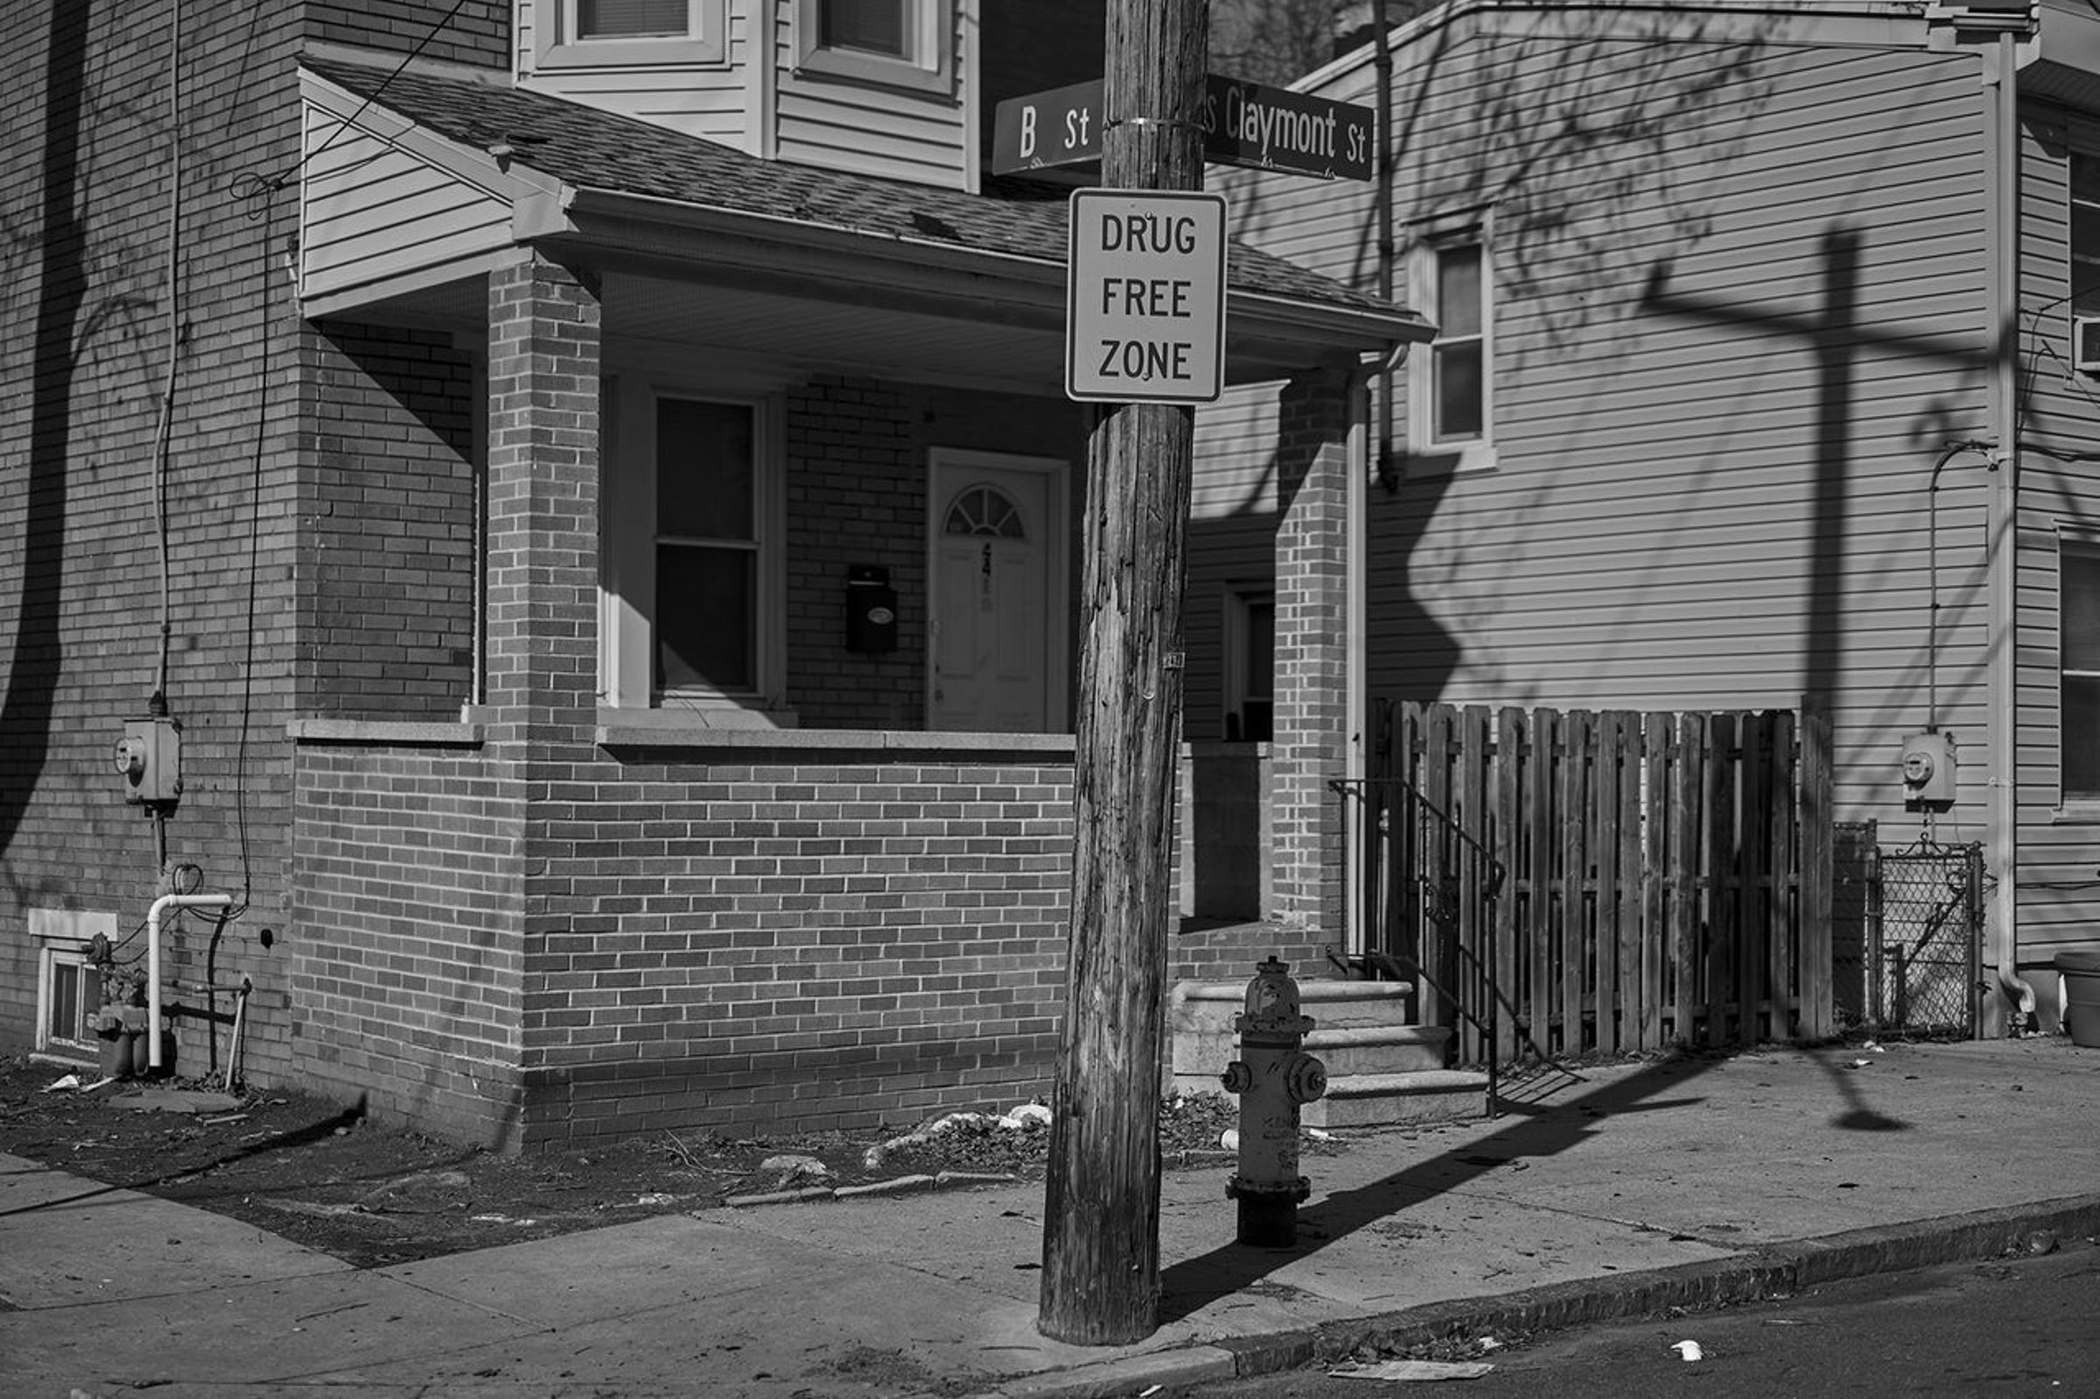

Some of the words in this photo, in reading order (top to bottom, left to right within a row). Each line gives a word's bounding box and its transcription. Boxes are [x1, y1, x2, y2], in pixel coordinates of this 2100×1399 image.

[1019, 105, 1037, 159] B
[1064, 107, 1090, 150] St
[1226, 85, 1337, 158] Claymont
[1346, 123, 1366, 164] St
[1101, 214, 1196, 254] DRUG
[1102, 278, 1192, 318] FREE
[1098, 339, 1192, 380] ZONE
